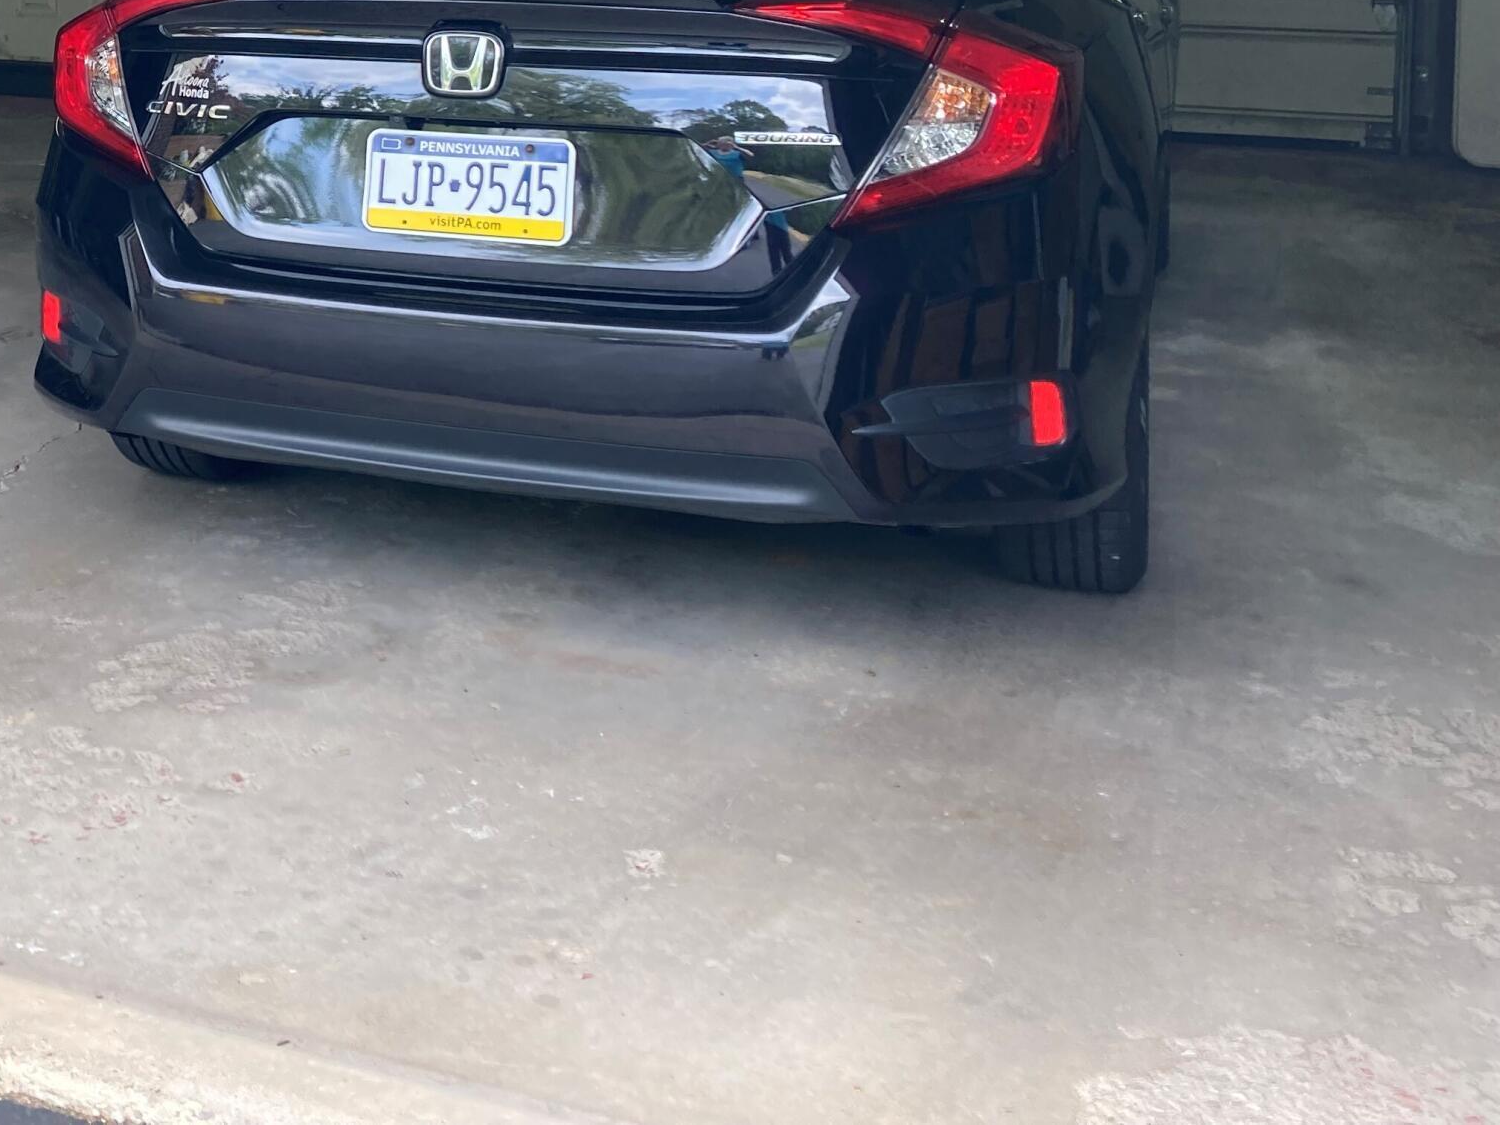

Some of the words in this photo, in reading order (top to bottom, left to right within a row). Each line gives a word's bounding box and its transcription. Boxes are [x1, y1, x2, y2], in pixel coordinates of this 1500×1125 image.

[179, 86, 210, 100] Honda
[146, 100, 231, 120] CIVIC
[740, 133, 834, 144] TOURING
[419, 140, 520, 157] PENNSYLVANIA
[430, 215, 501, 231] visitPA.com
